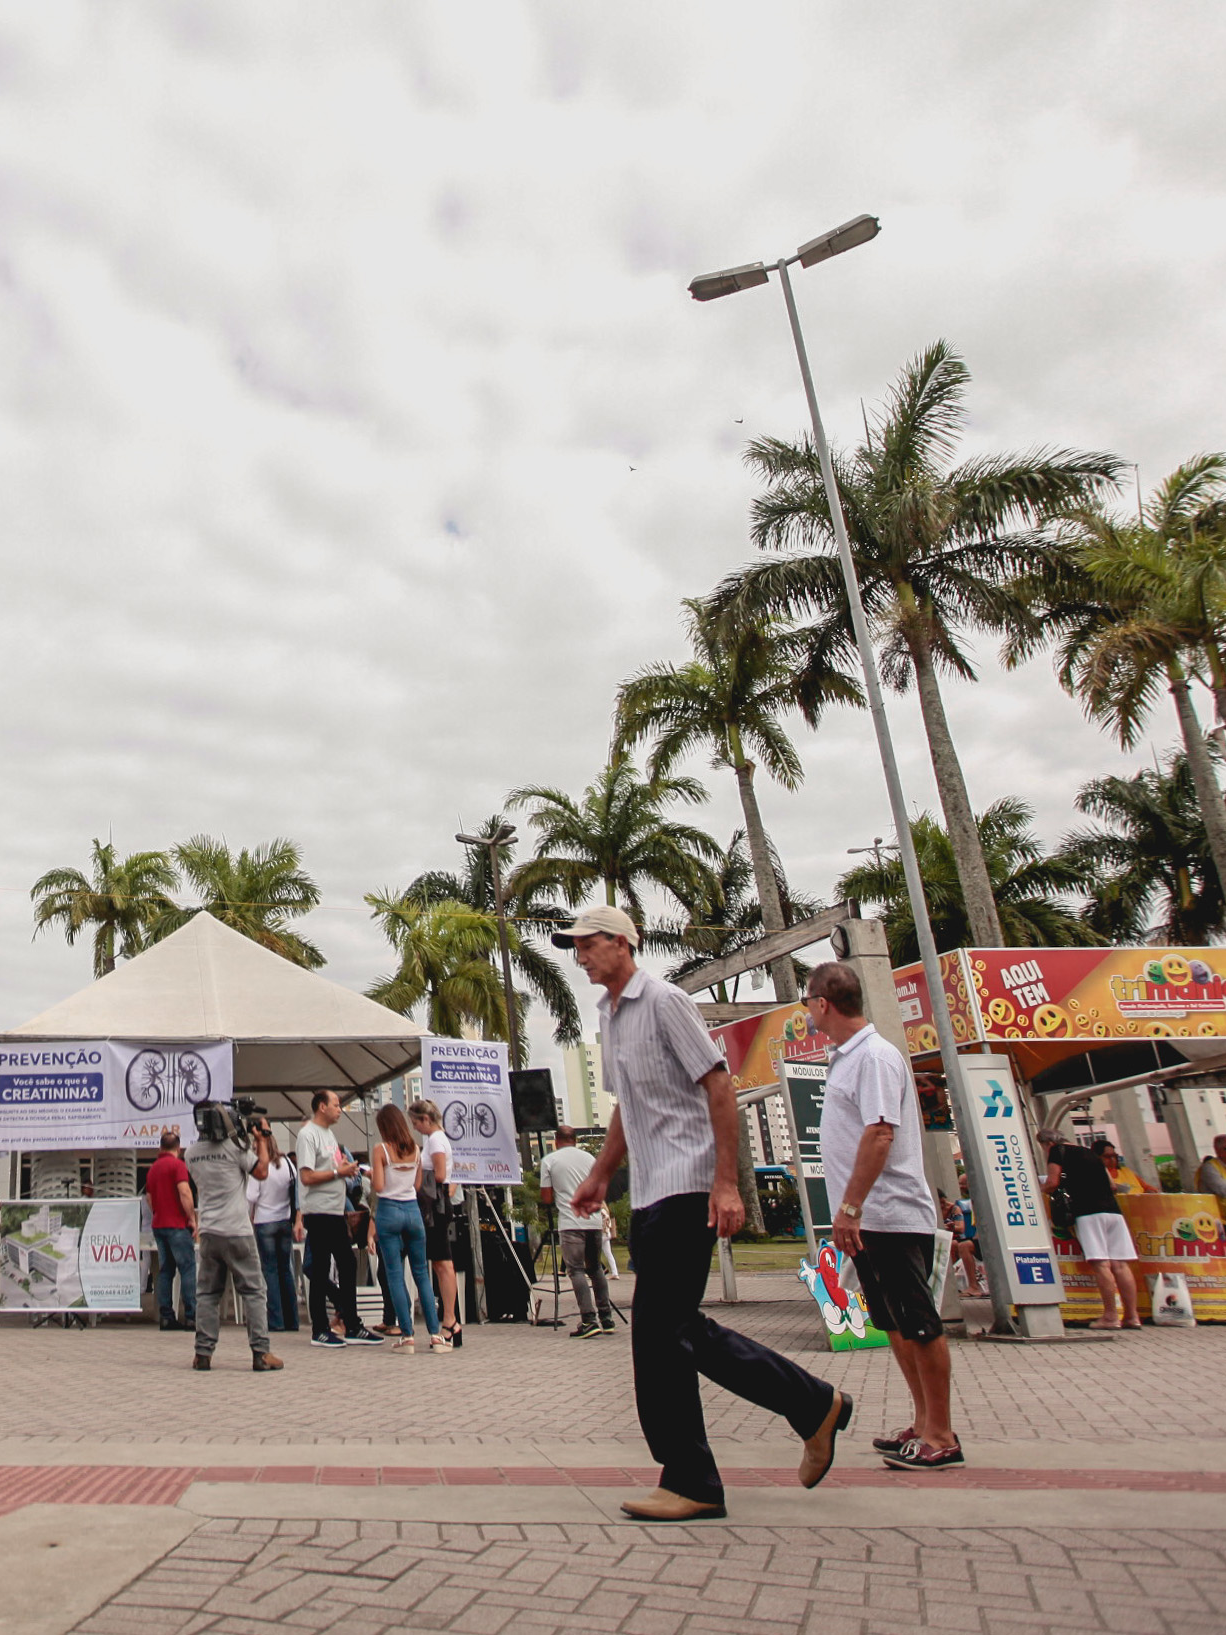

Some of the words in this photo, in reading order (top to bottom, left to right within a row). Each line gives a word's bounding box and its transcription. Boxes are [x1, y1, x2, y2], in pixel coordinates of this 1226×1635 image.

[1000, 960, 1044, 989] AQUI
[1011, 982, 1051, 1009] TEM
[432, 1046, 498, 1060] PREVENÇÃO
[434, 1070, 498, 1082] CREATININA?
[793, 1066, 824, 1077] MÓDULOS
[14, 1078, 34, 1086] Você
[35, 1077, 55, 1086] sabe
[64, 1078, 80, 1086] que
[82, 1076, 88, 1084] é
[2, 1086, 98, 1100] CREATININA?
[452, 1162, 476, 1171] PAR
[488, 1164, 510, 1172] VIDA
[987, 1134, 1024, 1226] Banrisul
[1010, 1134, 1038, 1226] ELETRÔNICO
[90, 1235, 124, 1246] RENAL
[91, 1244, 137, 1262] VIDA
[1032, 1266, 1044, 1282] E
